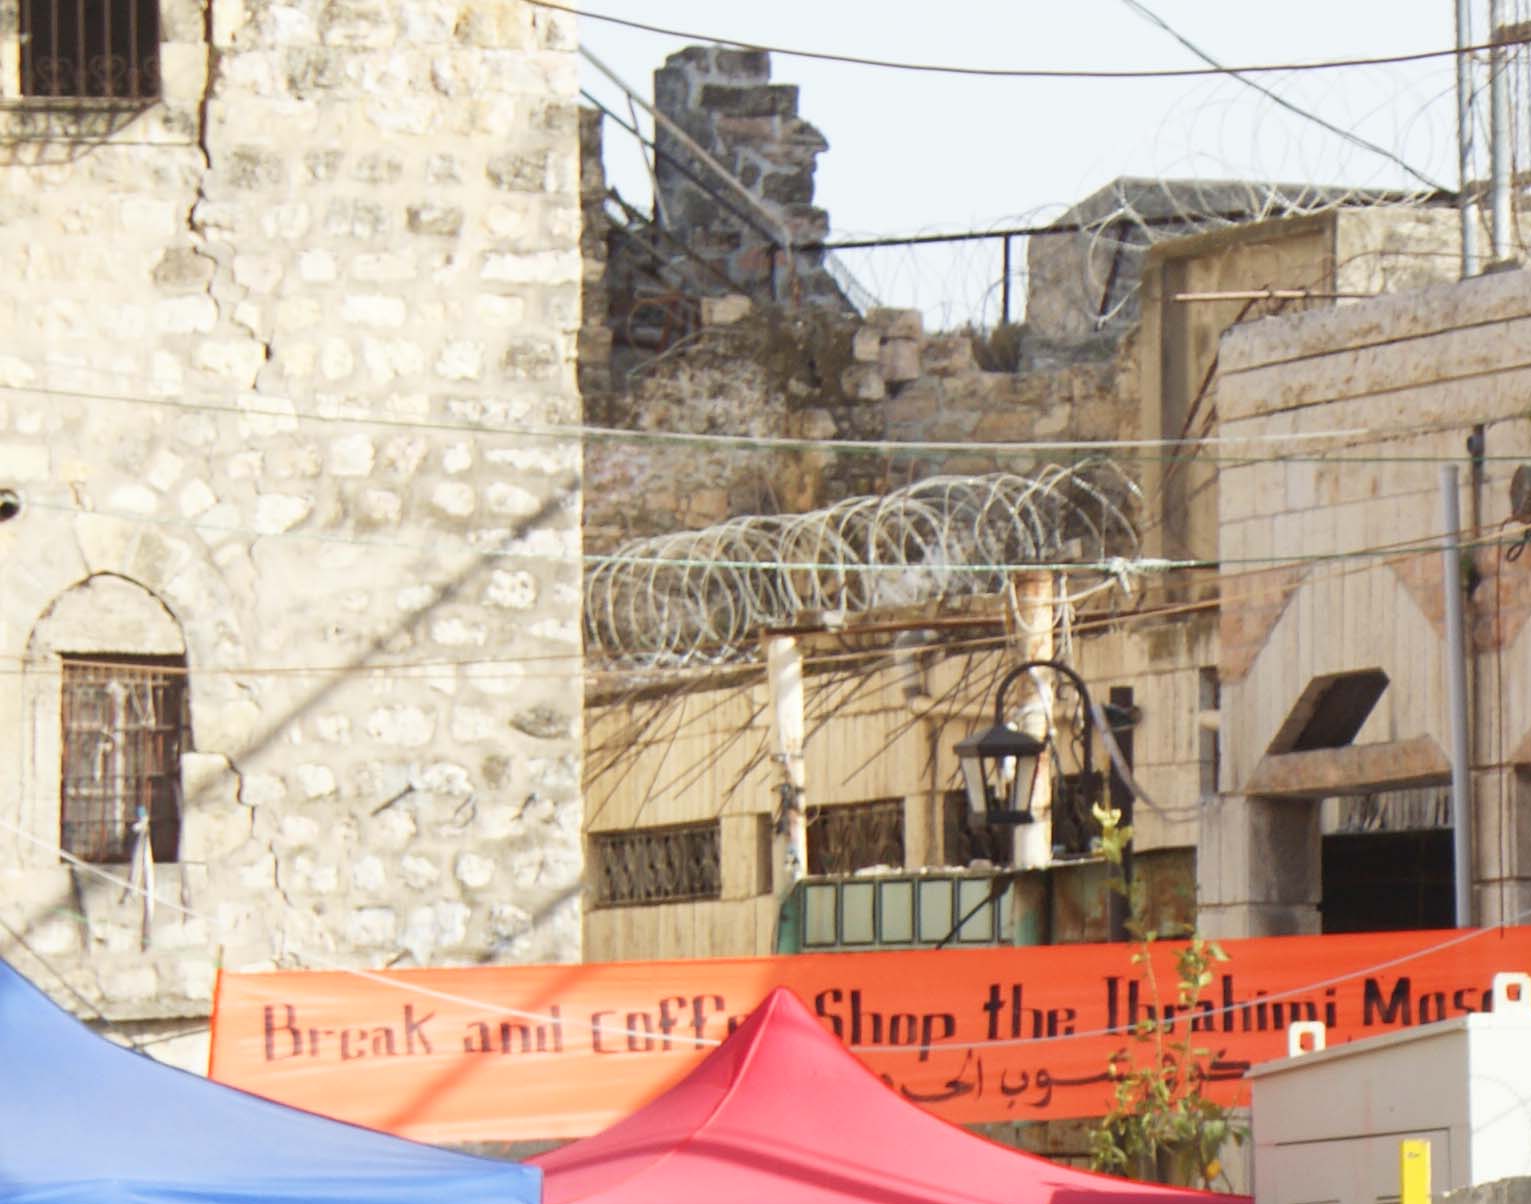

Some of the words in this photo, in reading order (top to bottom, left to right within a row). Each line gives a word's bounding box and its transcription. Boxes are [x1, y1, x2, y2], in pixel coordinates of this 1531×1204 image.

[463, 1005, 565, 1055] and
[590, 994, 752, 1056] coff
[814, 988, 957, 1062] Shop
[982, 983, 1077, 1041] the
[1104, 974, 1336, 1036] Ibrahimi
